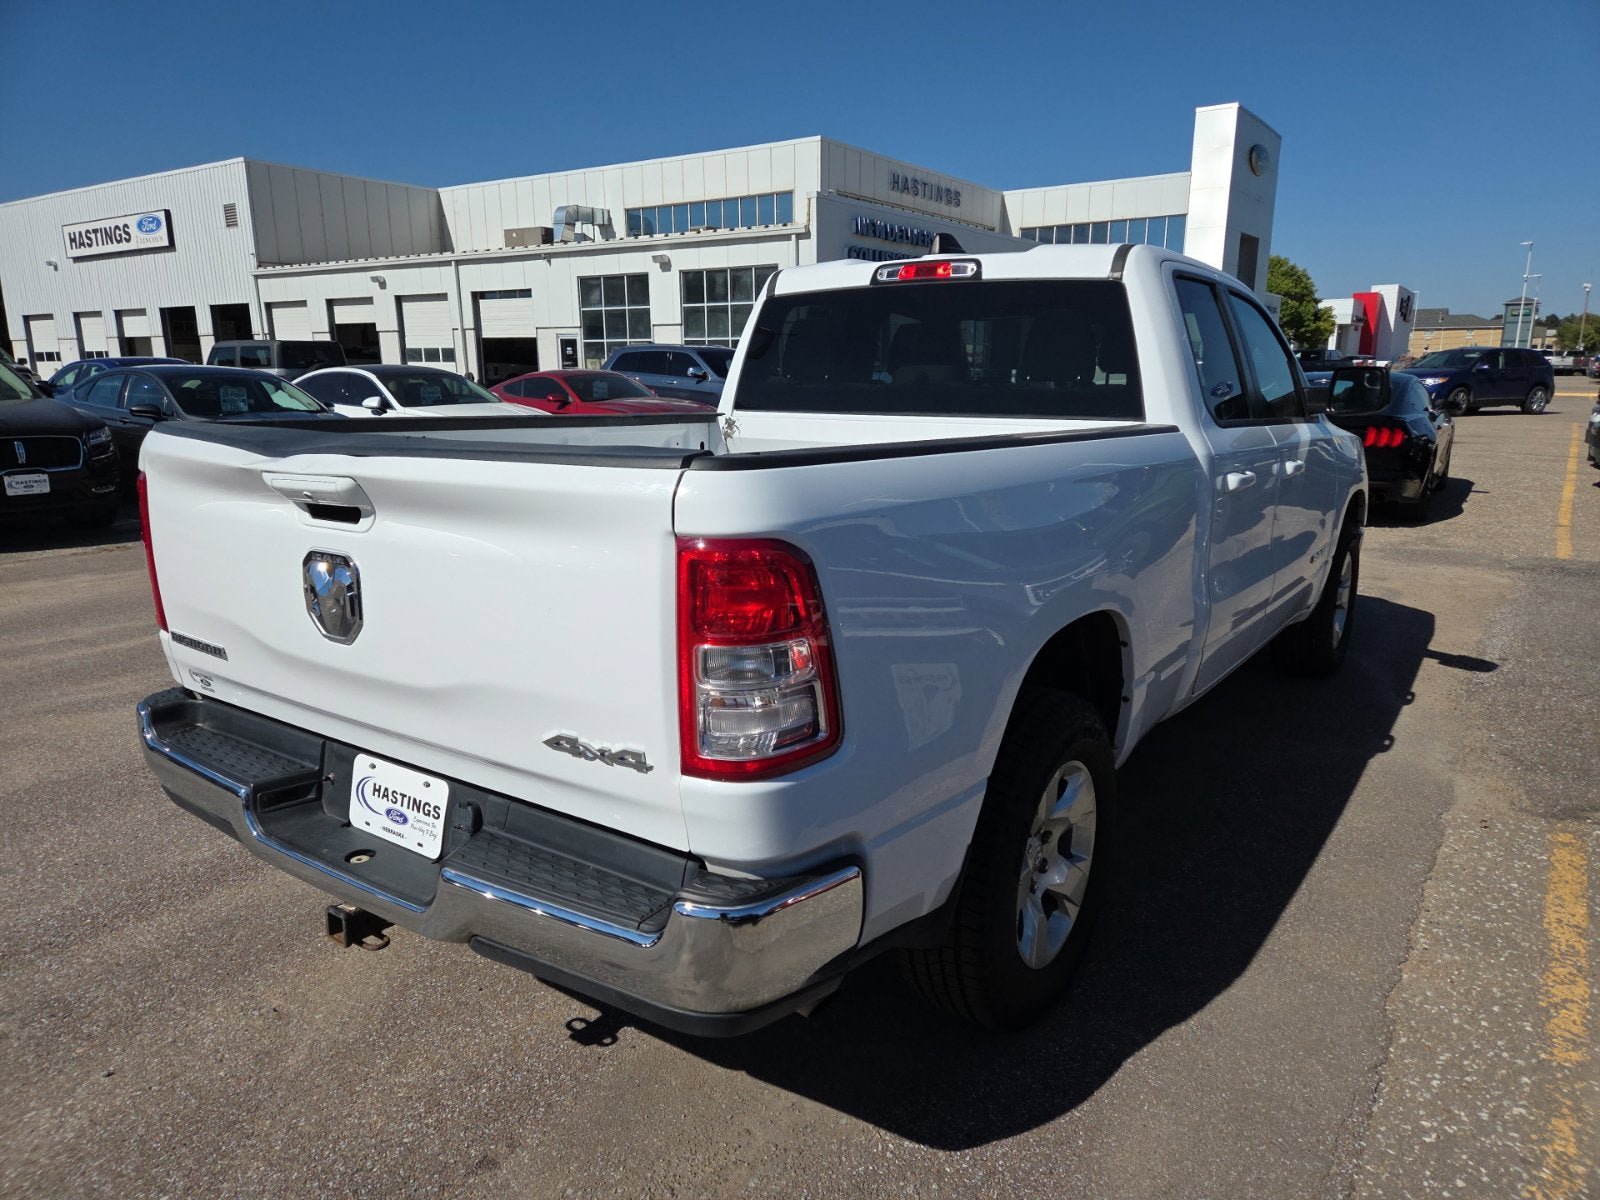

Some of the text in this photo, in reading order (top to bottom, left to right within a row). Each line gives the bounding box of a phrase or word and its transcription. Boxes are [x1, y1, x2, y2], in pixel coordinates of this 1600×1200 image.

[890, 172, 962, 208] HASTINGS
[141, 217, 158, 232] Ford
[68, 223, 132, 250] HASTINGS
[848, 245, 912, 262] COLLIS
[372, 782, 441, 820] HASTINGS
[387, 808, 406, 824] Ford
